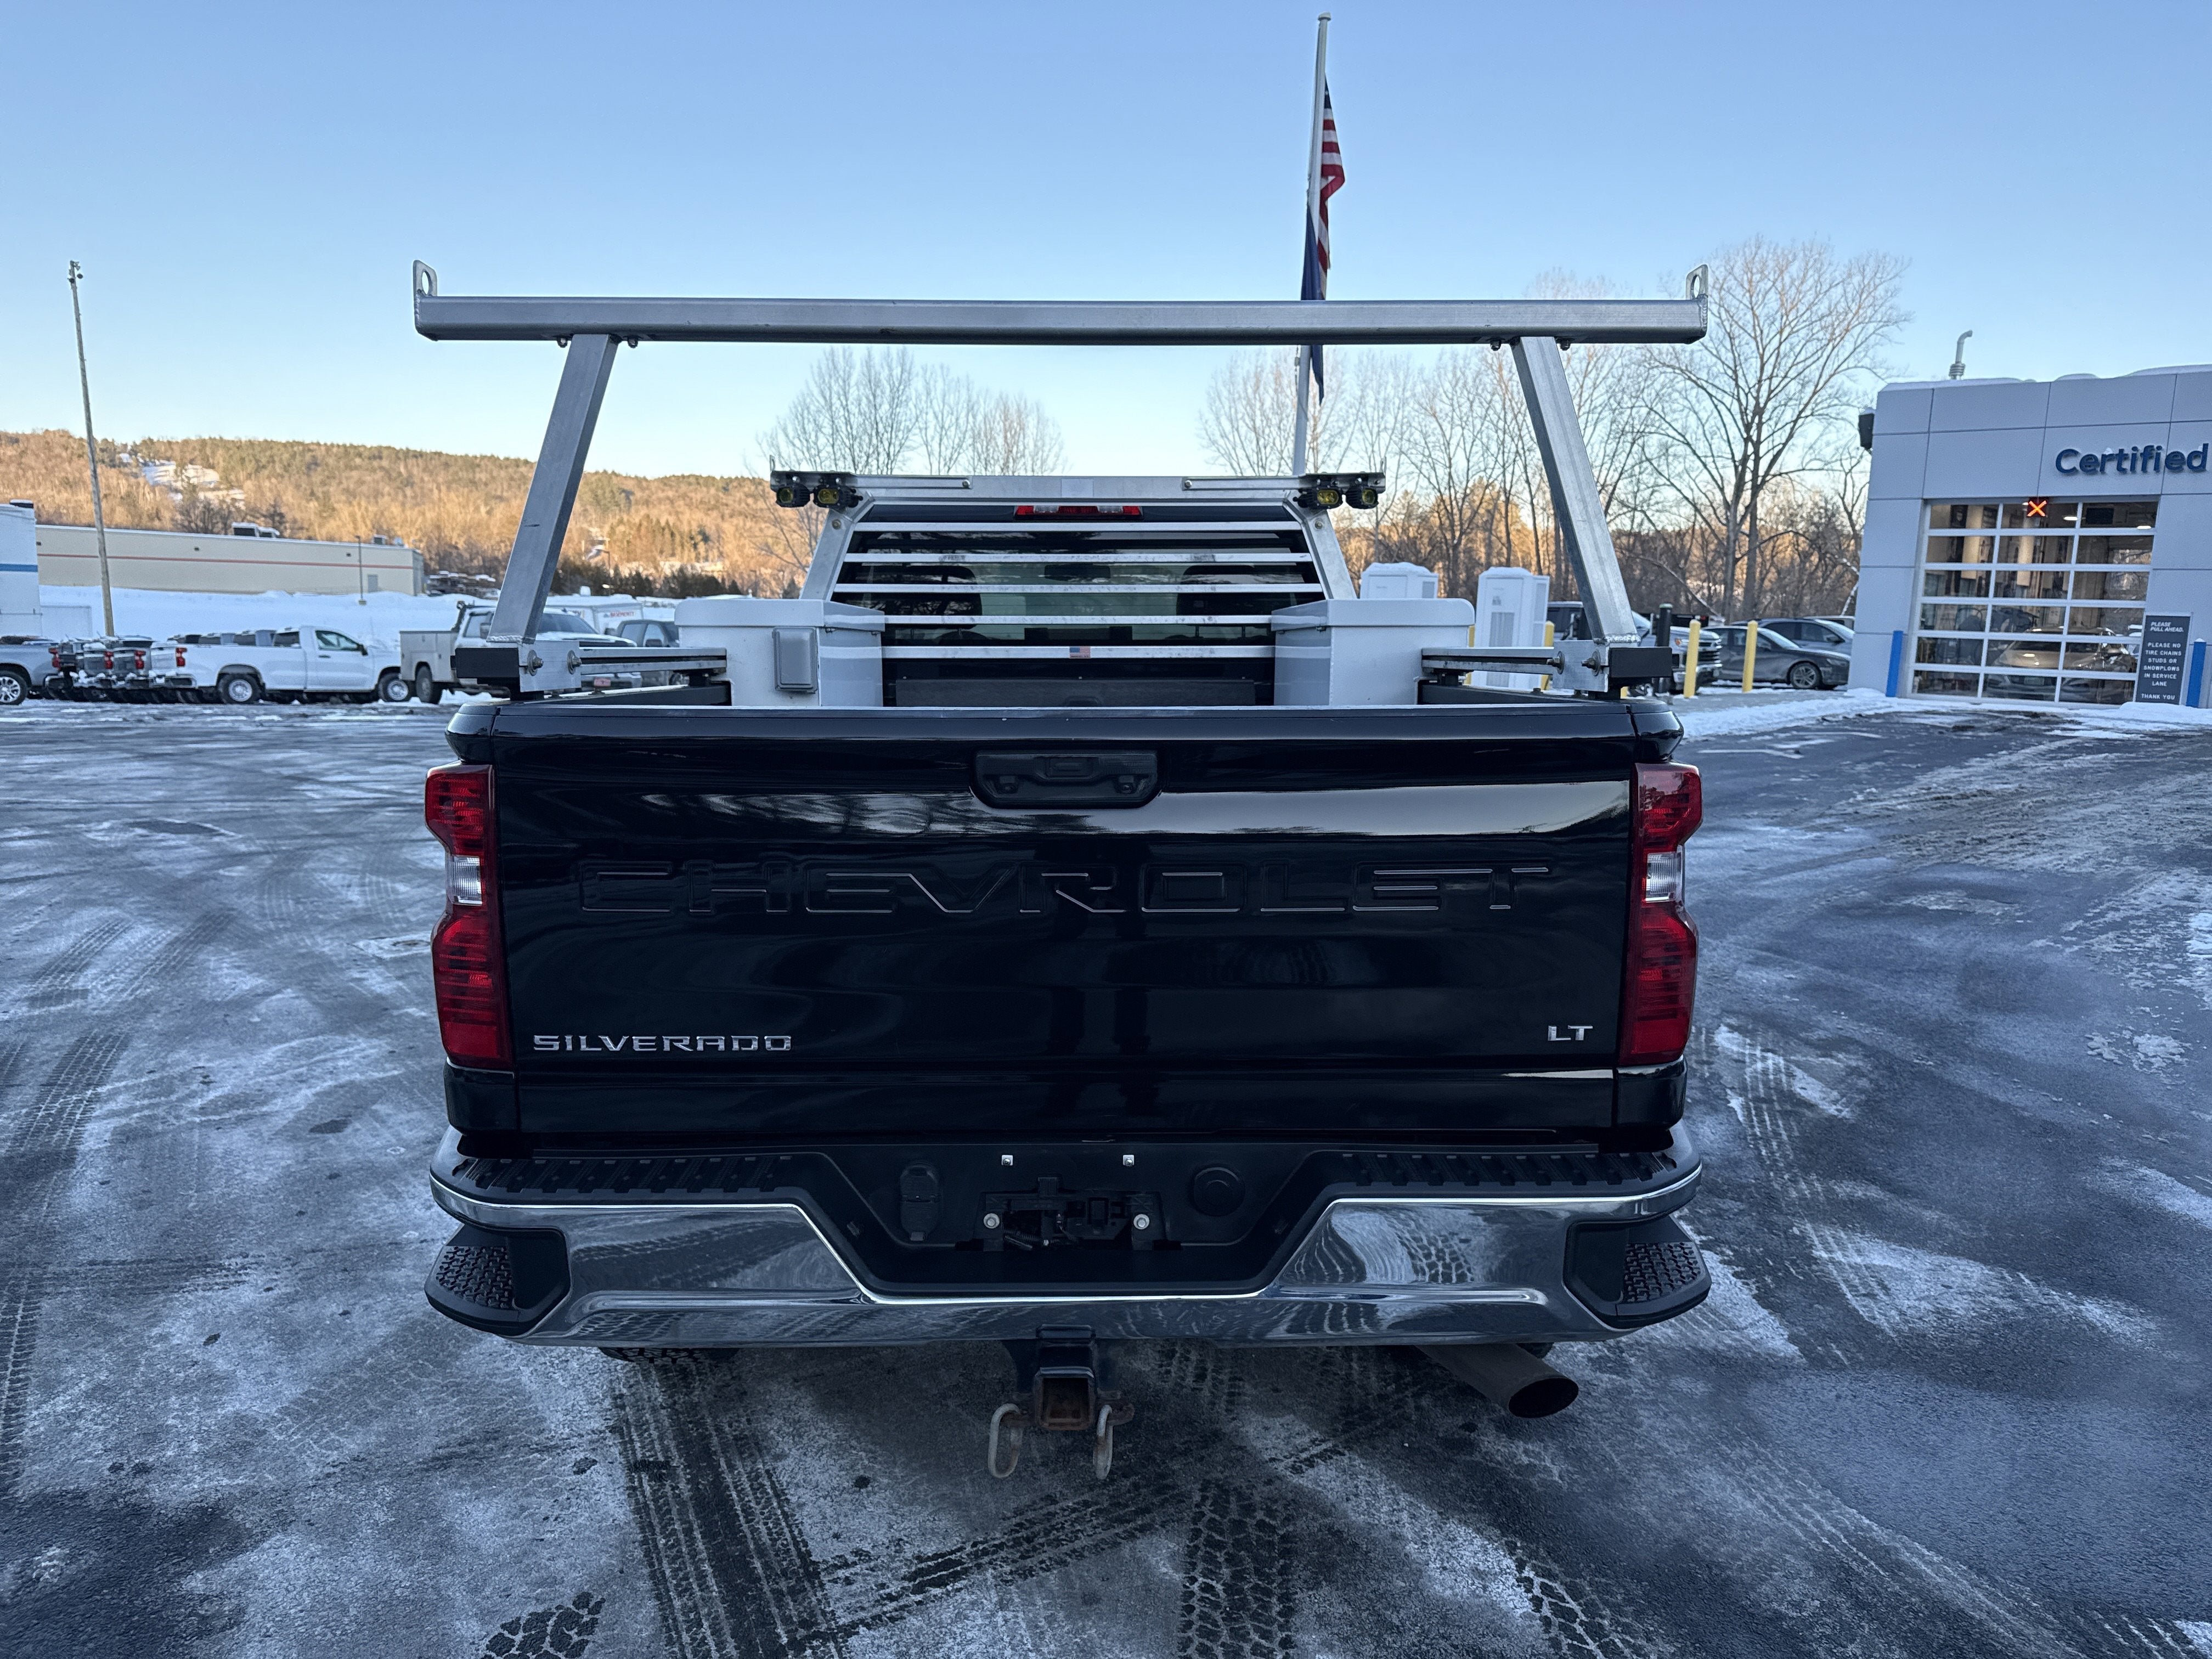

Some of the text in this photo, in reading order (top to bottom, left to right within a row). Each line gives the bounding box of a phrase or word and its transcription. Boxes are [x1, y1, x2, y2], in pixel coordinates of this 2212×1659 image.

[2056, 443, 2209, 475] Certified
[579, 860, 1550, 913] CHEVROLET
[533, 1035, 792, 1052] SILVERADO
[1547, 1025, 1593, 1041] LT
